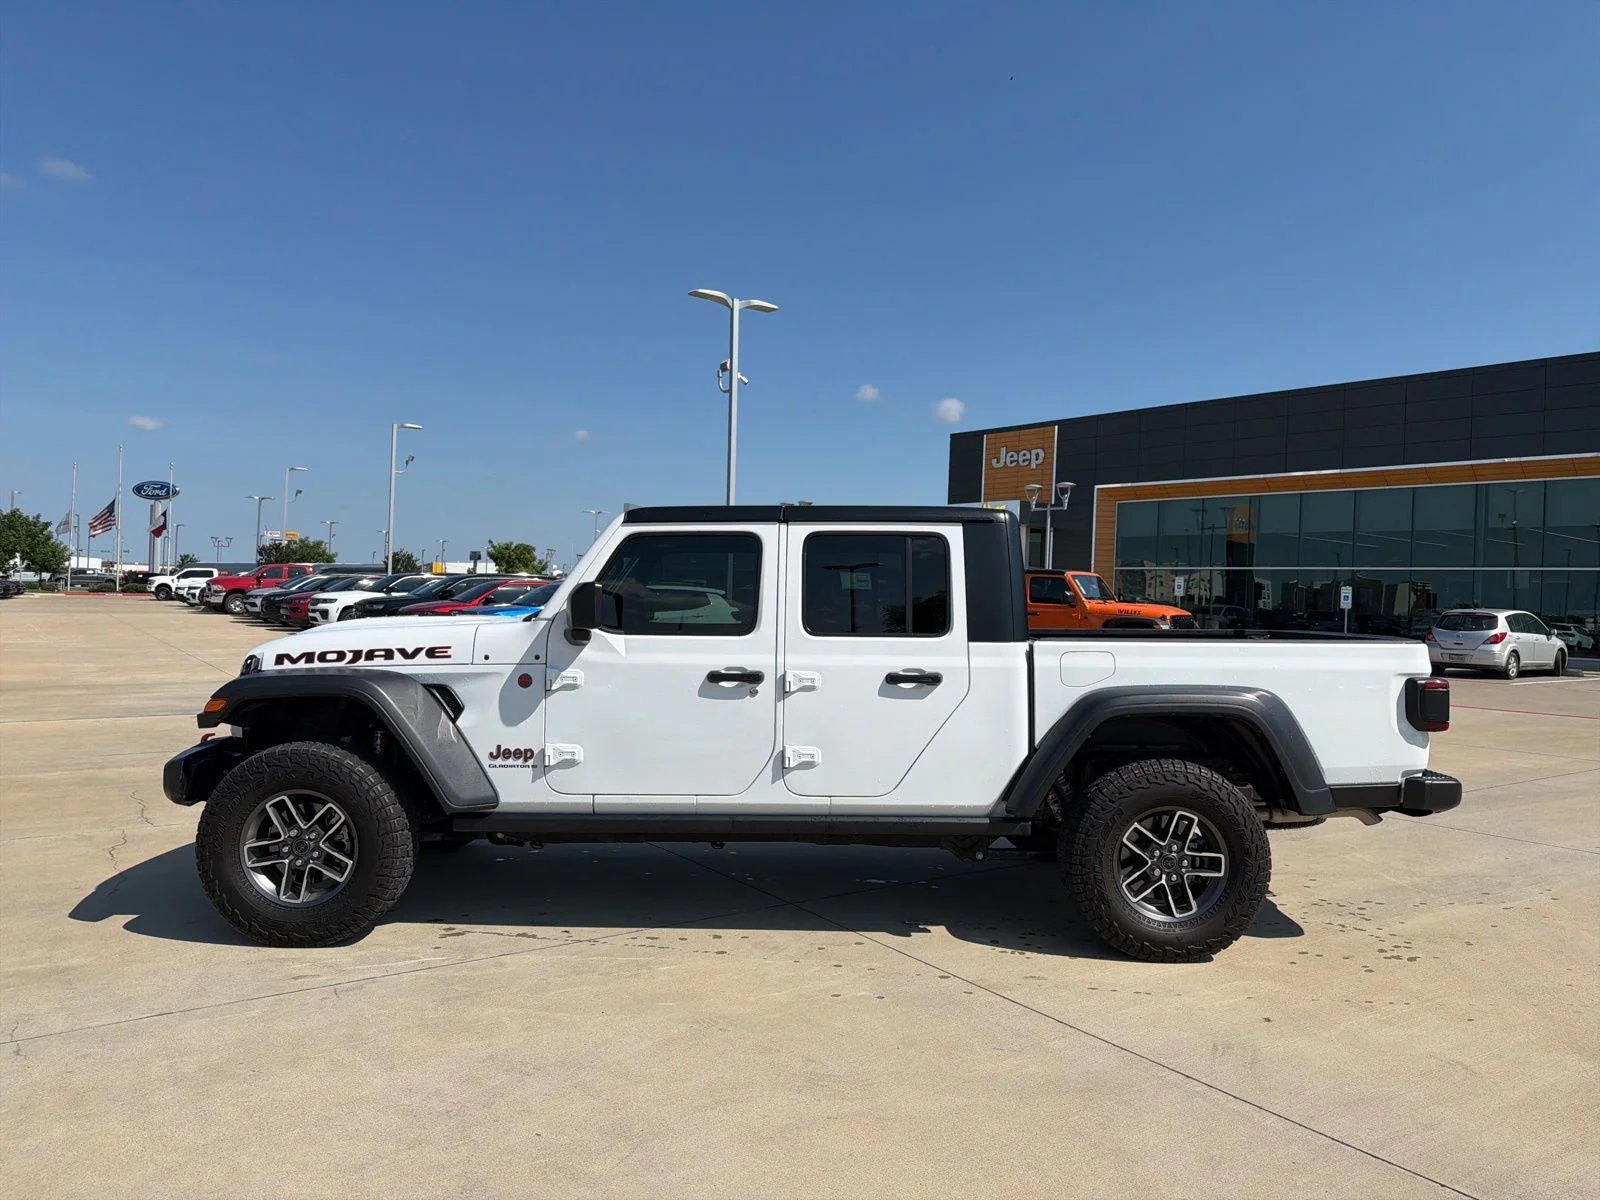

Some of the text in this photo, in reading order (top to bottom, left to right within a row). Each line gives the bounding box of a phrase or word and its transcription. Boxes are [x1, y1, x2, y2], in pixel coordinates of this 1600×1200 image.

[991, 446, 1045, 469] Jeep
[141, 484, 168, 496] Ford
[274, 646, 452, 666] MOJAVE
[488, 744, 535, 763] Jeep
